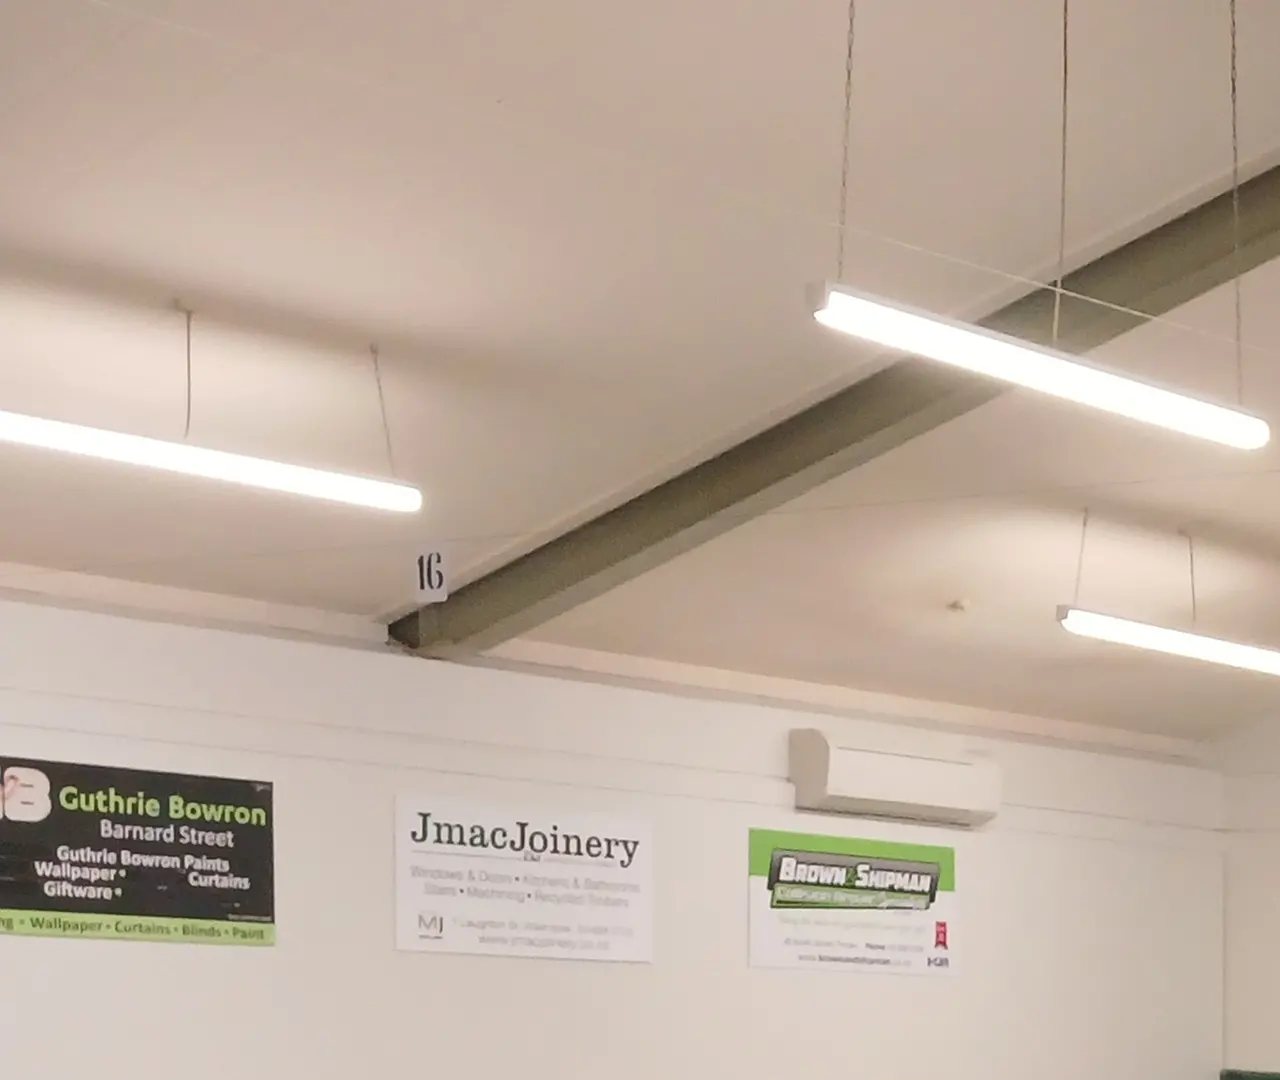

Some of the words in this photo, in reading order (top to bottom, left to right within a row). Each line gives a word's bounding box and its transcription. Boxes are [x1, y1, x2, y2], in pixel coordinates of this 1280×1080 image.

[417, 552, 444, 590] 16
[59, 786, 160, 817] Guthrie
[169, 795, 266, 826] Bowron
[100, 819, 174, 844] Barnard
[179, 825, 235, 848] Street
[410, 811, 640, 868] JmacJoinery
[34, 861, 117, 883] Wallpaper
[57, 845, 117, 866] Guthrie
[120, 850, 181, 869] Bowron
[184, 854, 230, 872] Paints
[43, 881, 113, 900] Giftware
[188, 872, 250, 890] Curtains
[30, 917, 103, 935] Wallpaper
[115, 920, 171, 935] Curtains
[182, 925, 222, 938] Blinds
